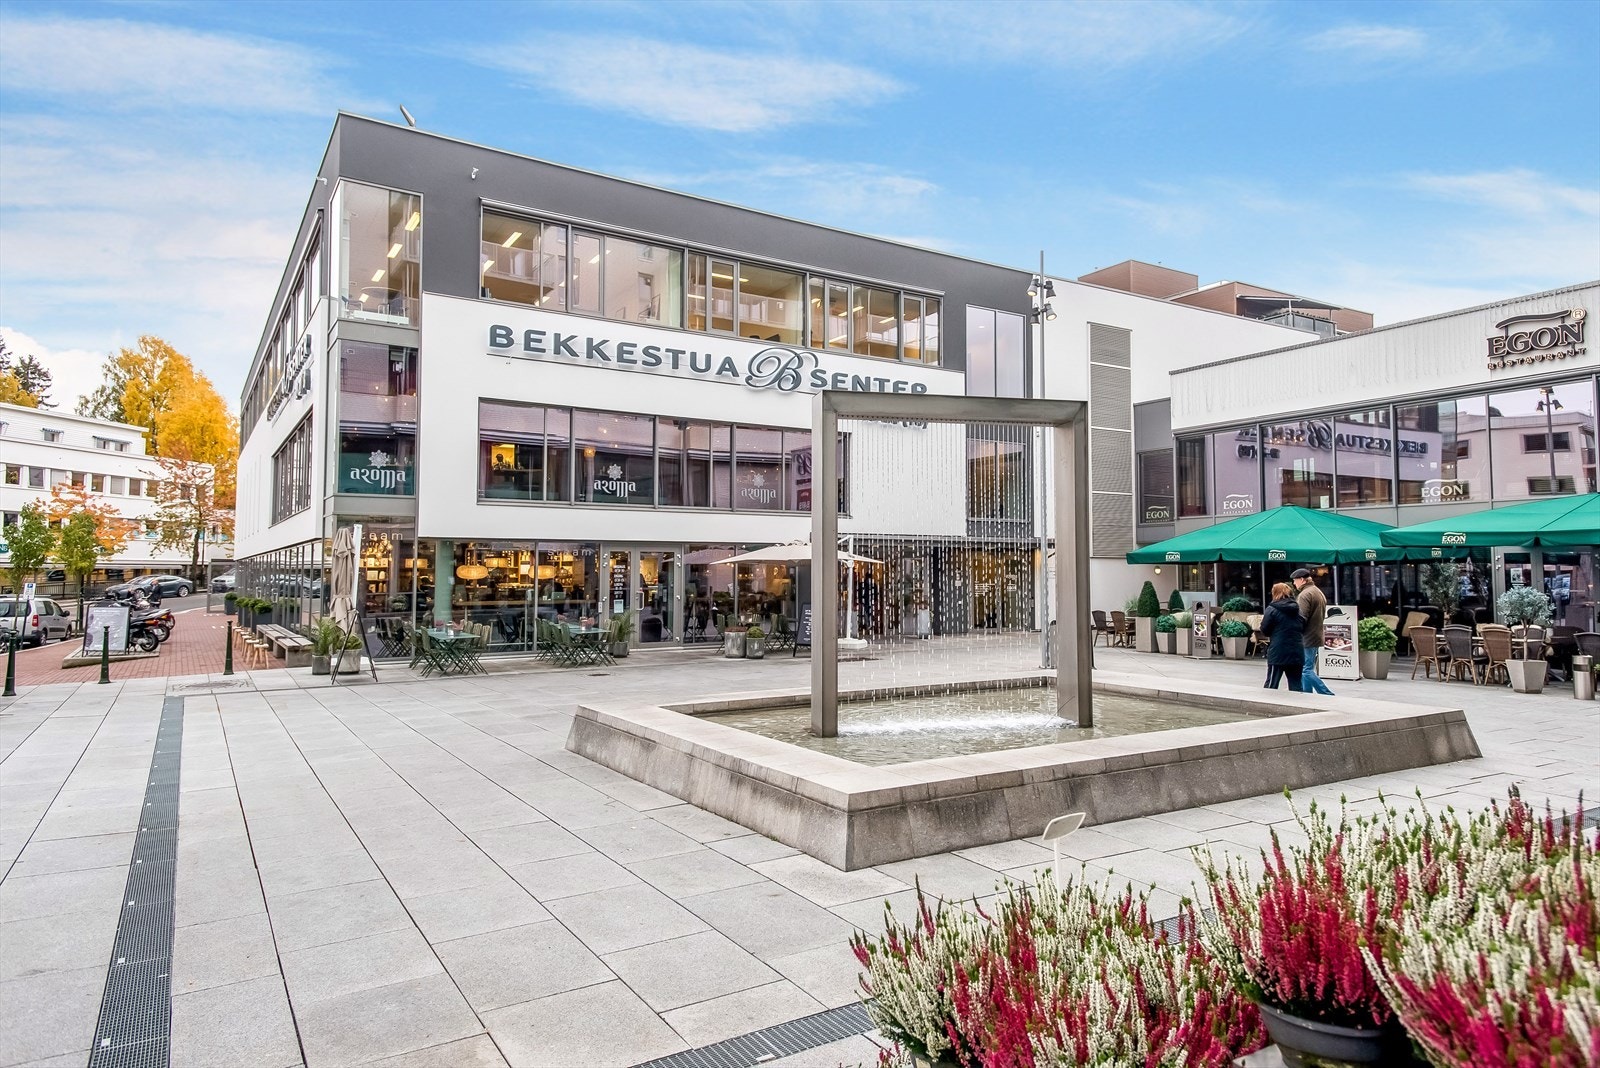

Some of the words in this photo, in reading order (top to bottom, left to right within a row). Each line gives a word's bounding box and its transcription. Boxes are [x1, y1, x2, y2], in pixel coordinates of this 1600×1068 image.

[1486, 320, 1584, 357] EGON
[489, 324, 740, 377] BEKKESTUA
[1487, 348, 1586, 370] RESTAURANT
[350, 467, 406, 489] aroma
[593, 480, 636, 498] aroma
[741, 487, 776, 504] aroma
[1421, 484, 1463, 498] EGON
[1223, 499, 1253, 510] EGON
[1146, 510, 1170, 519] EGON
[1325, 658, 1352, 666] EGON
